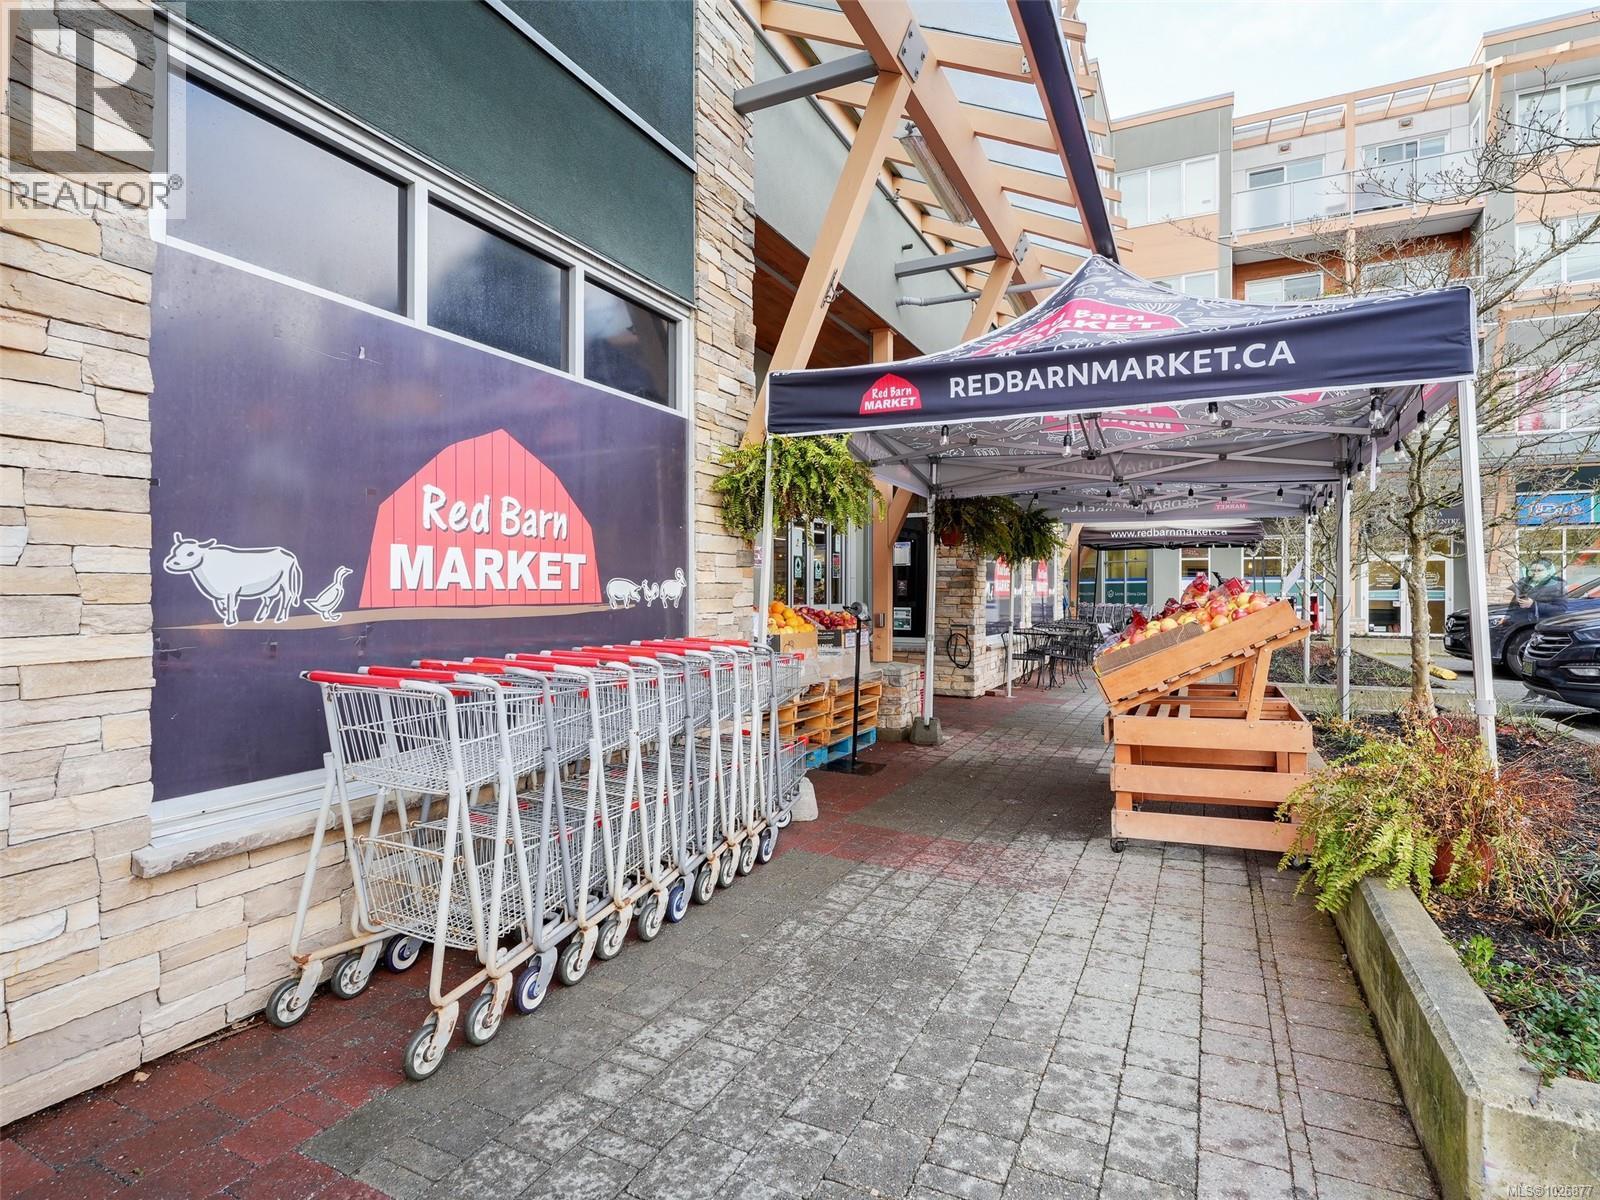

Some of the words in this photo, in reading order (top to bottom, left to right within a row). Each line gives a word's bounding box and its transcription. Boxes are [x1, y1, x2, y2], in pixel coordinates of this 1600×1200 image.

[1074, 309, 1145, 321] Barn
[949, 340, 1296, 398] REDBARNMARKET.CA
[871, 387, 888, 399] Red
[889, 386, 912, 397] Barn
[864, 396, 917, 411] MARKET
[422, 483, 491, 533] Red
[500, 495, 568, 540] Barn
[1110, 528, 1228, 538] www.redbarnmarket.ca
[389, 543, 587, 591] MARKET
